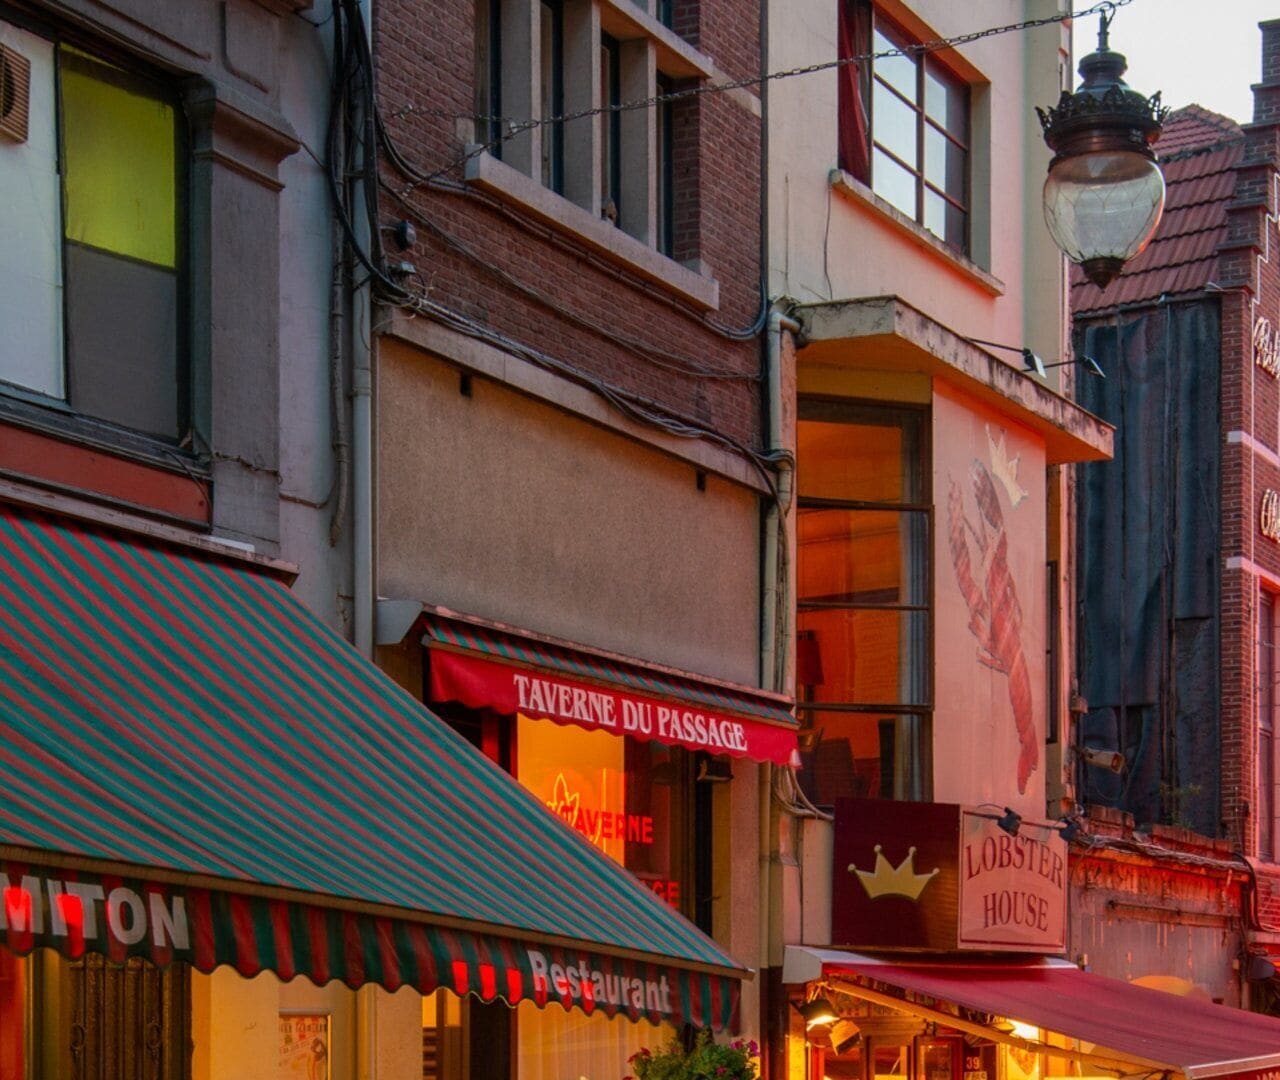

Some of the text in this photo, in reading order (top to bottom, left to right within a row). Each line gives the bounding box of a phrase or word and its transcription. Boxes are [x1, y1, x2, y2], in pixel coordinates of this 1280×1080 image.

[513, 675, 748, 752] TAVERNE DU PASSAGE
[965, 833, 1064, 890] LOBSTER
[982, 892, 1049, 933] HOUSE
[526, 951, 672, 1014] Restaurant
[966, 1056, 980, 1070] 39
